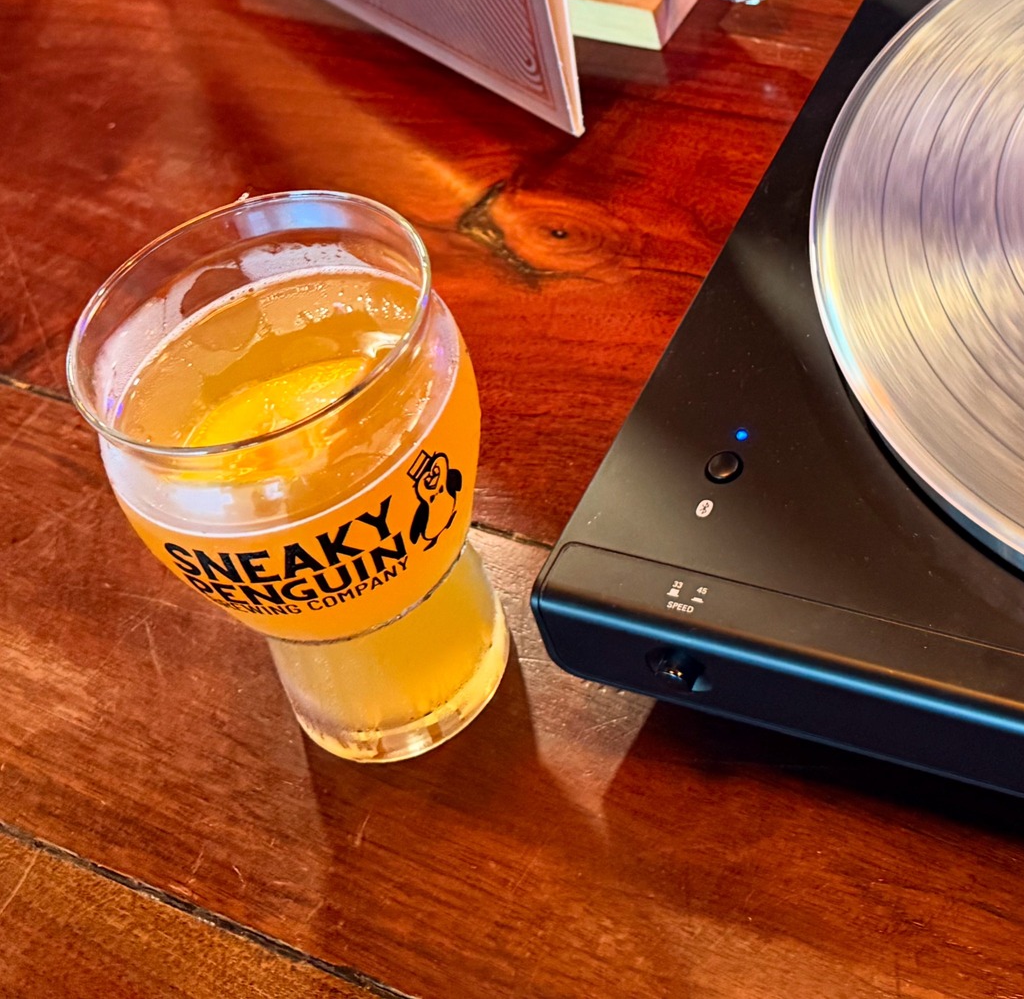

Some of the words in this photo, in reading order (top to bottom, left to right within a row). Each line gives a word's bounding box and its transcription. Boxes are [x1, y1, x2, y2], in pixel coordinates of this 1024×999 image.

[164, 495, 393, 584] SNEAKY
[184, 531, 408, 605] PENGUIN
[308, 556, 408, 611] COMPANY
[672, 580, 684, 590] 33
[696, 586, 708, 595] 45
[666, 600, 695, 614] SPEED
